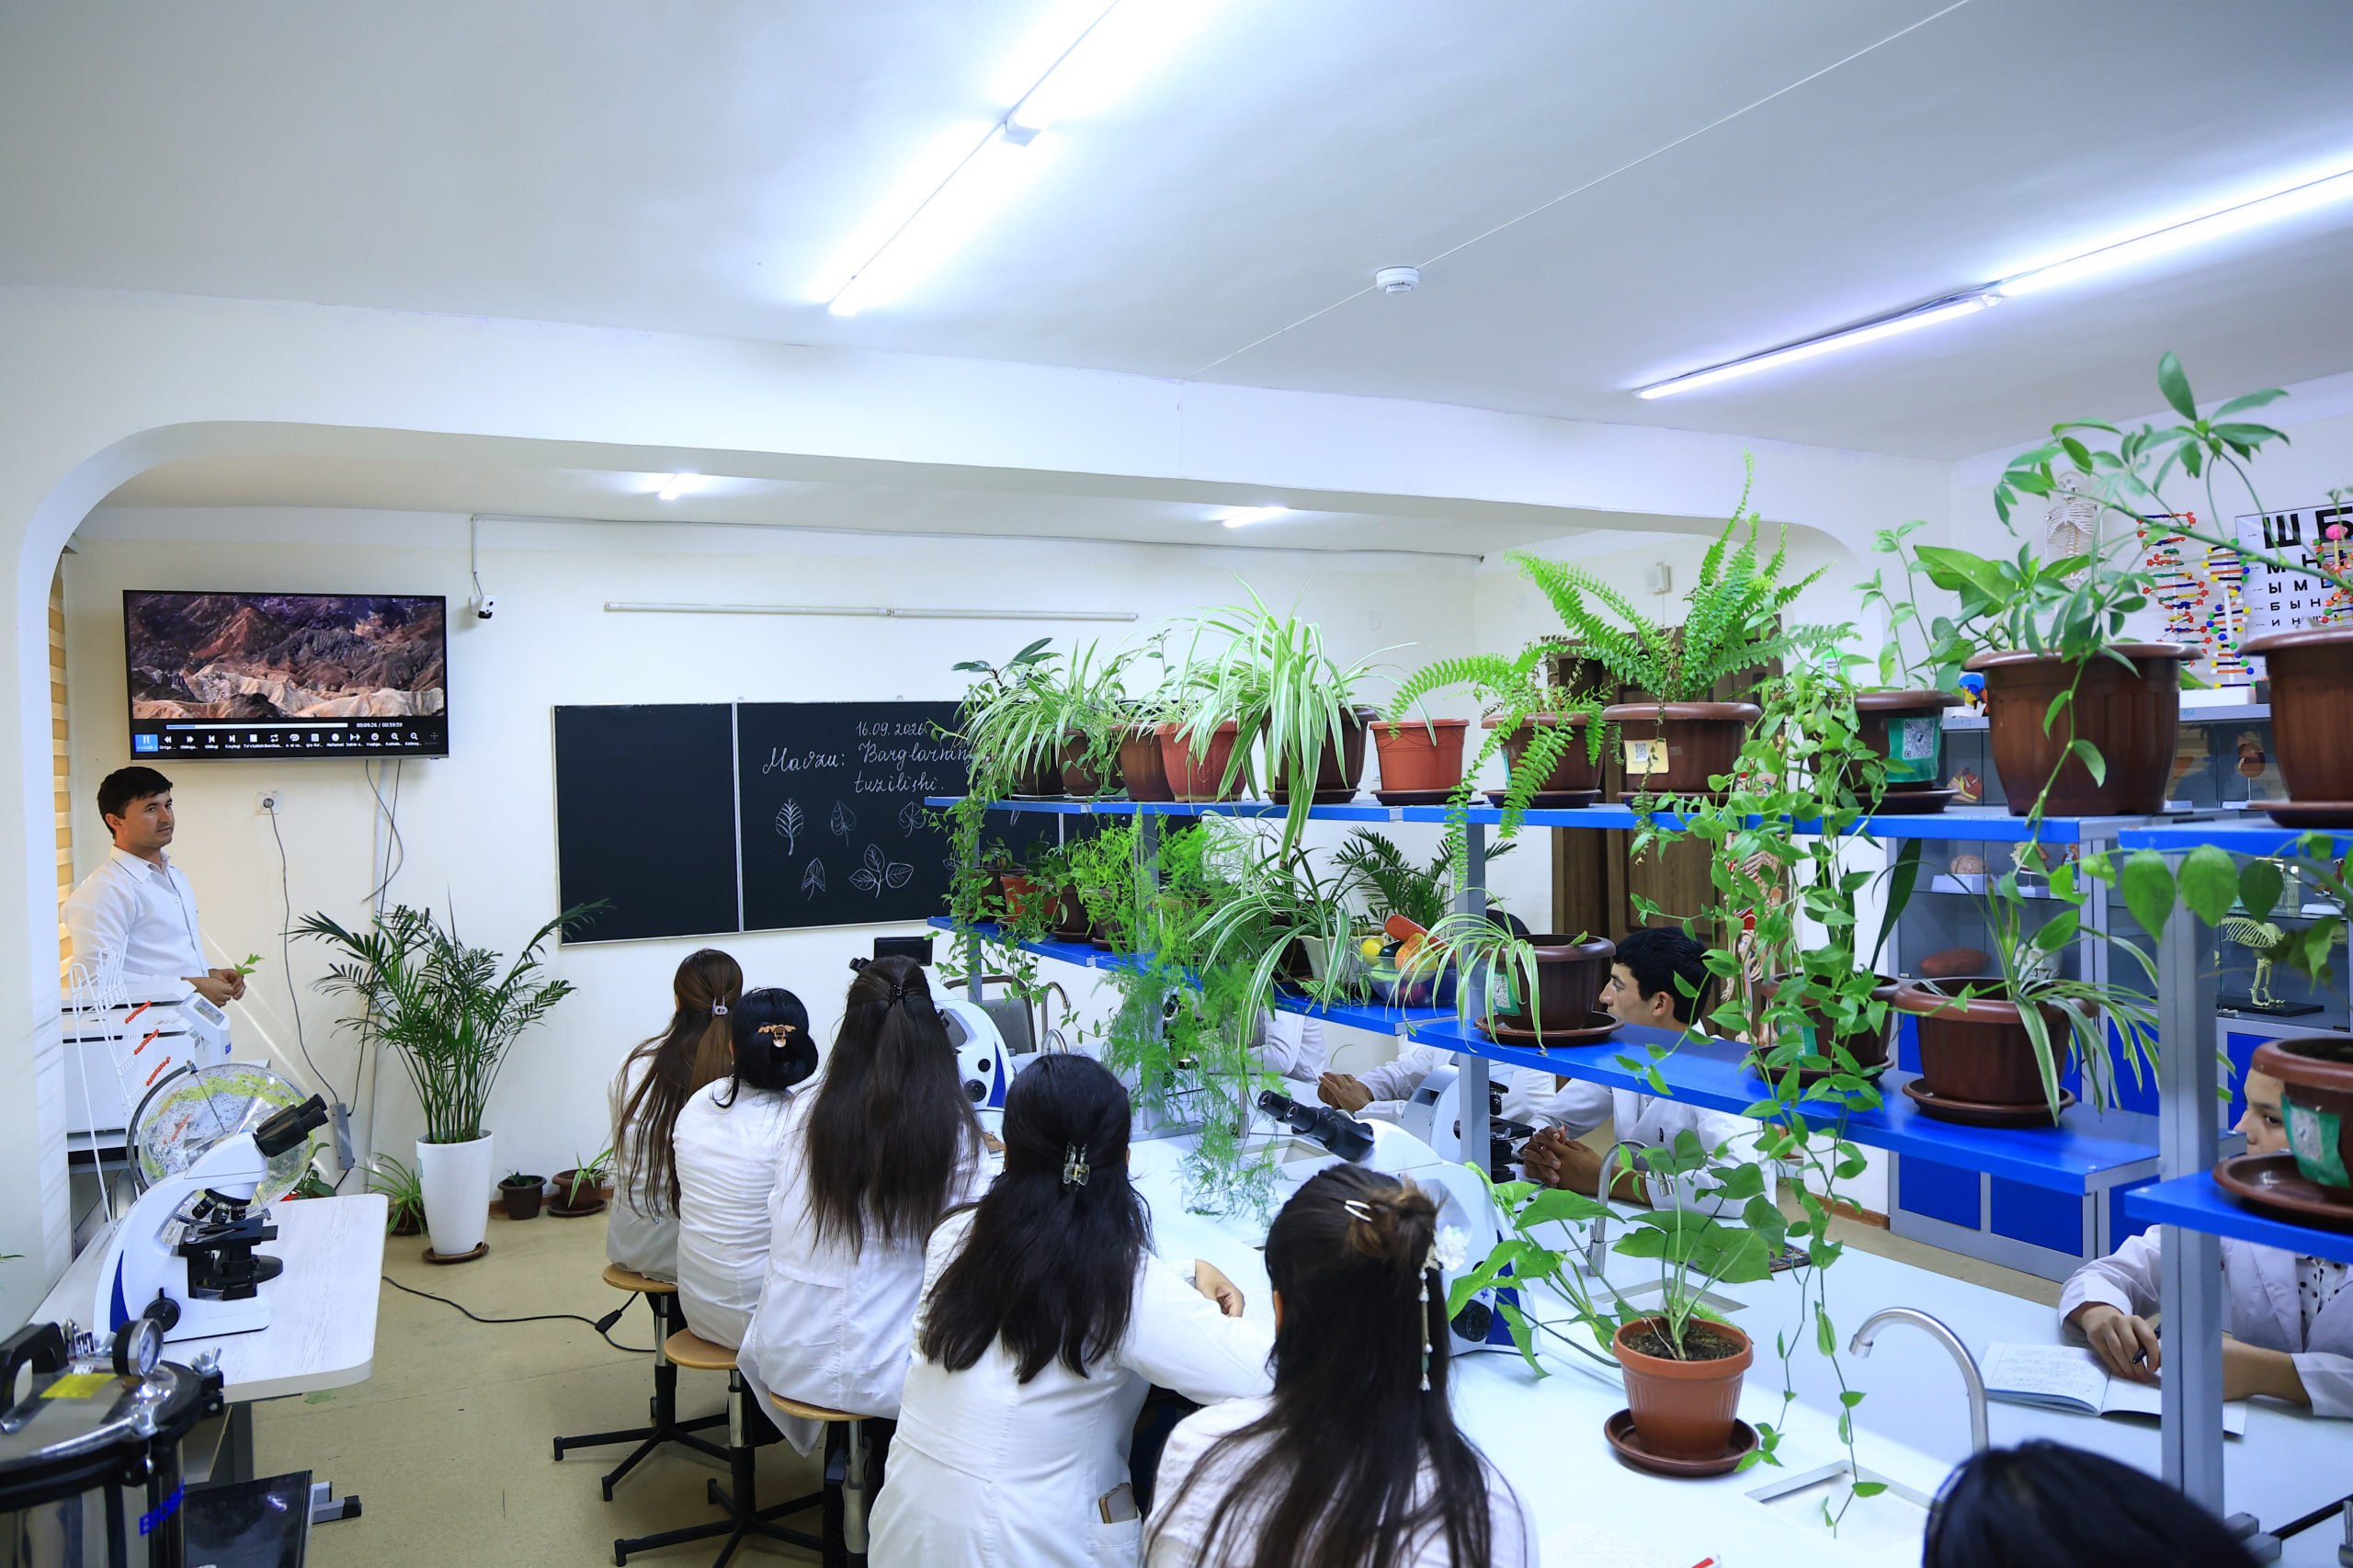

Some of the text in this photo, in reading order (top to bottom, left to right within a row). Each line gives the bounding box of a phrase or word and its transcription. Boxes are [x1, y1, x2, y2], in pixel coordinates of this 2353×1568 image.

[2262, 513, 2302, 550] Ш
[2268, 582, 2282, 595] Ы
[2293, 579, 2309, 592] М
[2270, 601, 2280, 611] Б
[2290, 599, 2301, 609] Ы
[2310, 597, 2321, 608] Н
[2272, 619, 2280, 627] И
[2292, 617, 2301, 625] Н
[762, 747, 845, 775] Mavzu:
